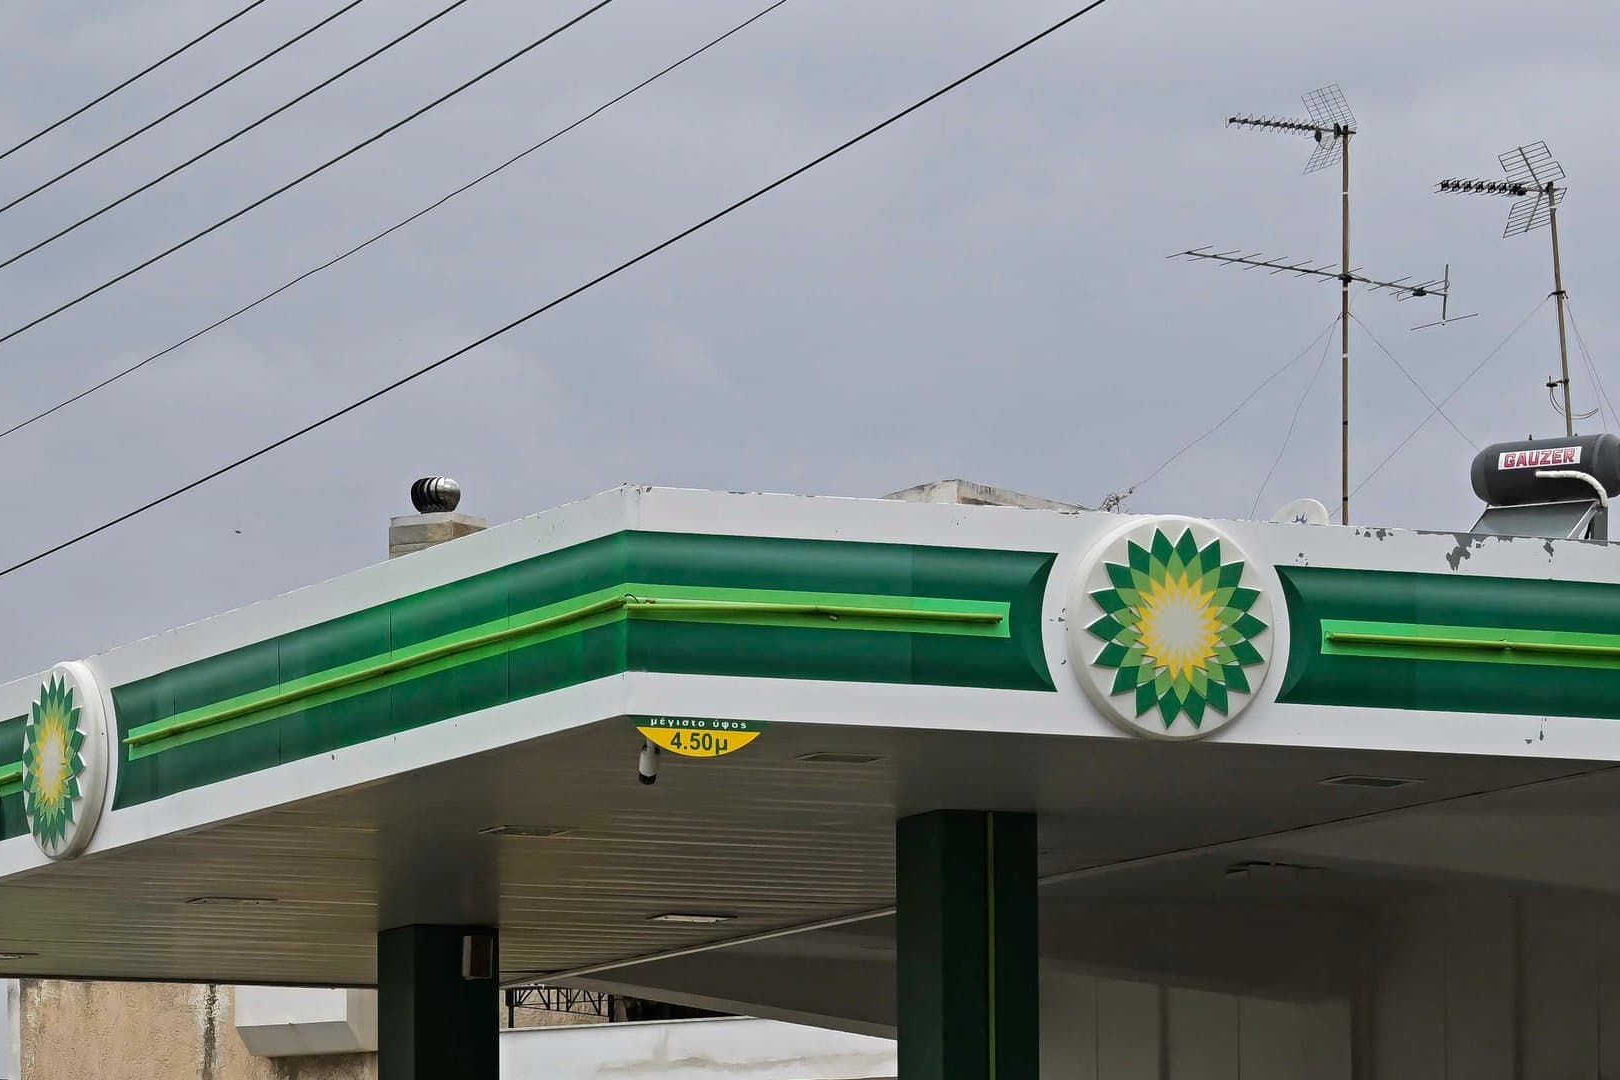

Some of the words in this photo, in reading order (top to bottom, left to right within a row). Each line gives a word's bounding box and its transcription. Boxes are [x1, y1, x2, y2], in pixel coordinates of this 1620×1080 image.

[1504, 448, 1575, 468] GAUZER
[650, 717, 705, 727] μέγιστο
[712, 719, 747, 730] ύψος
